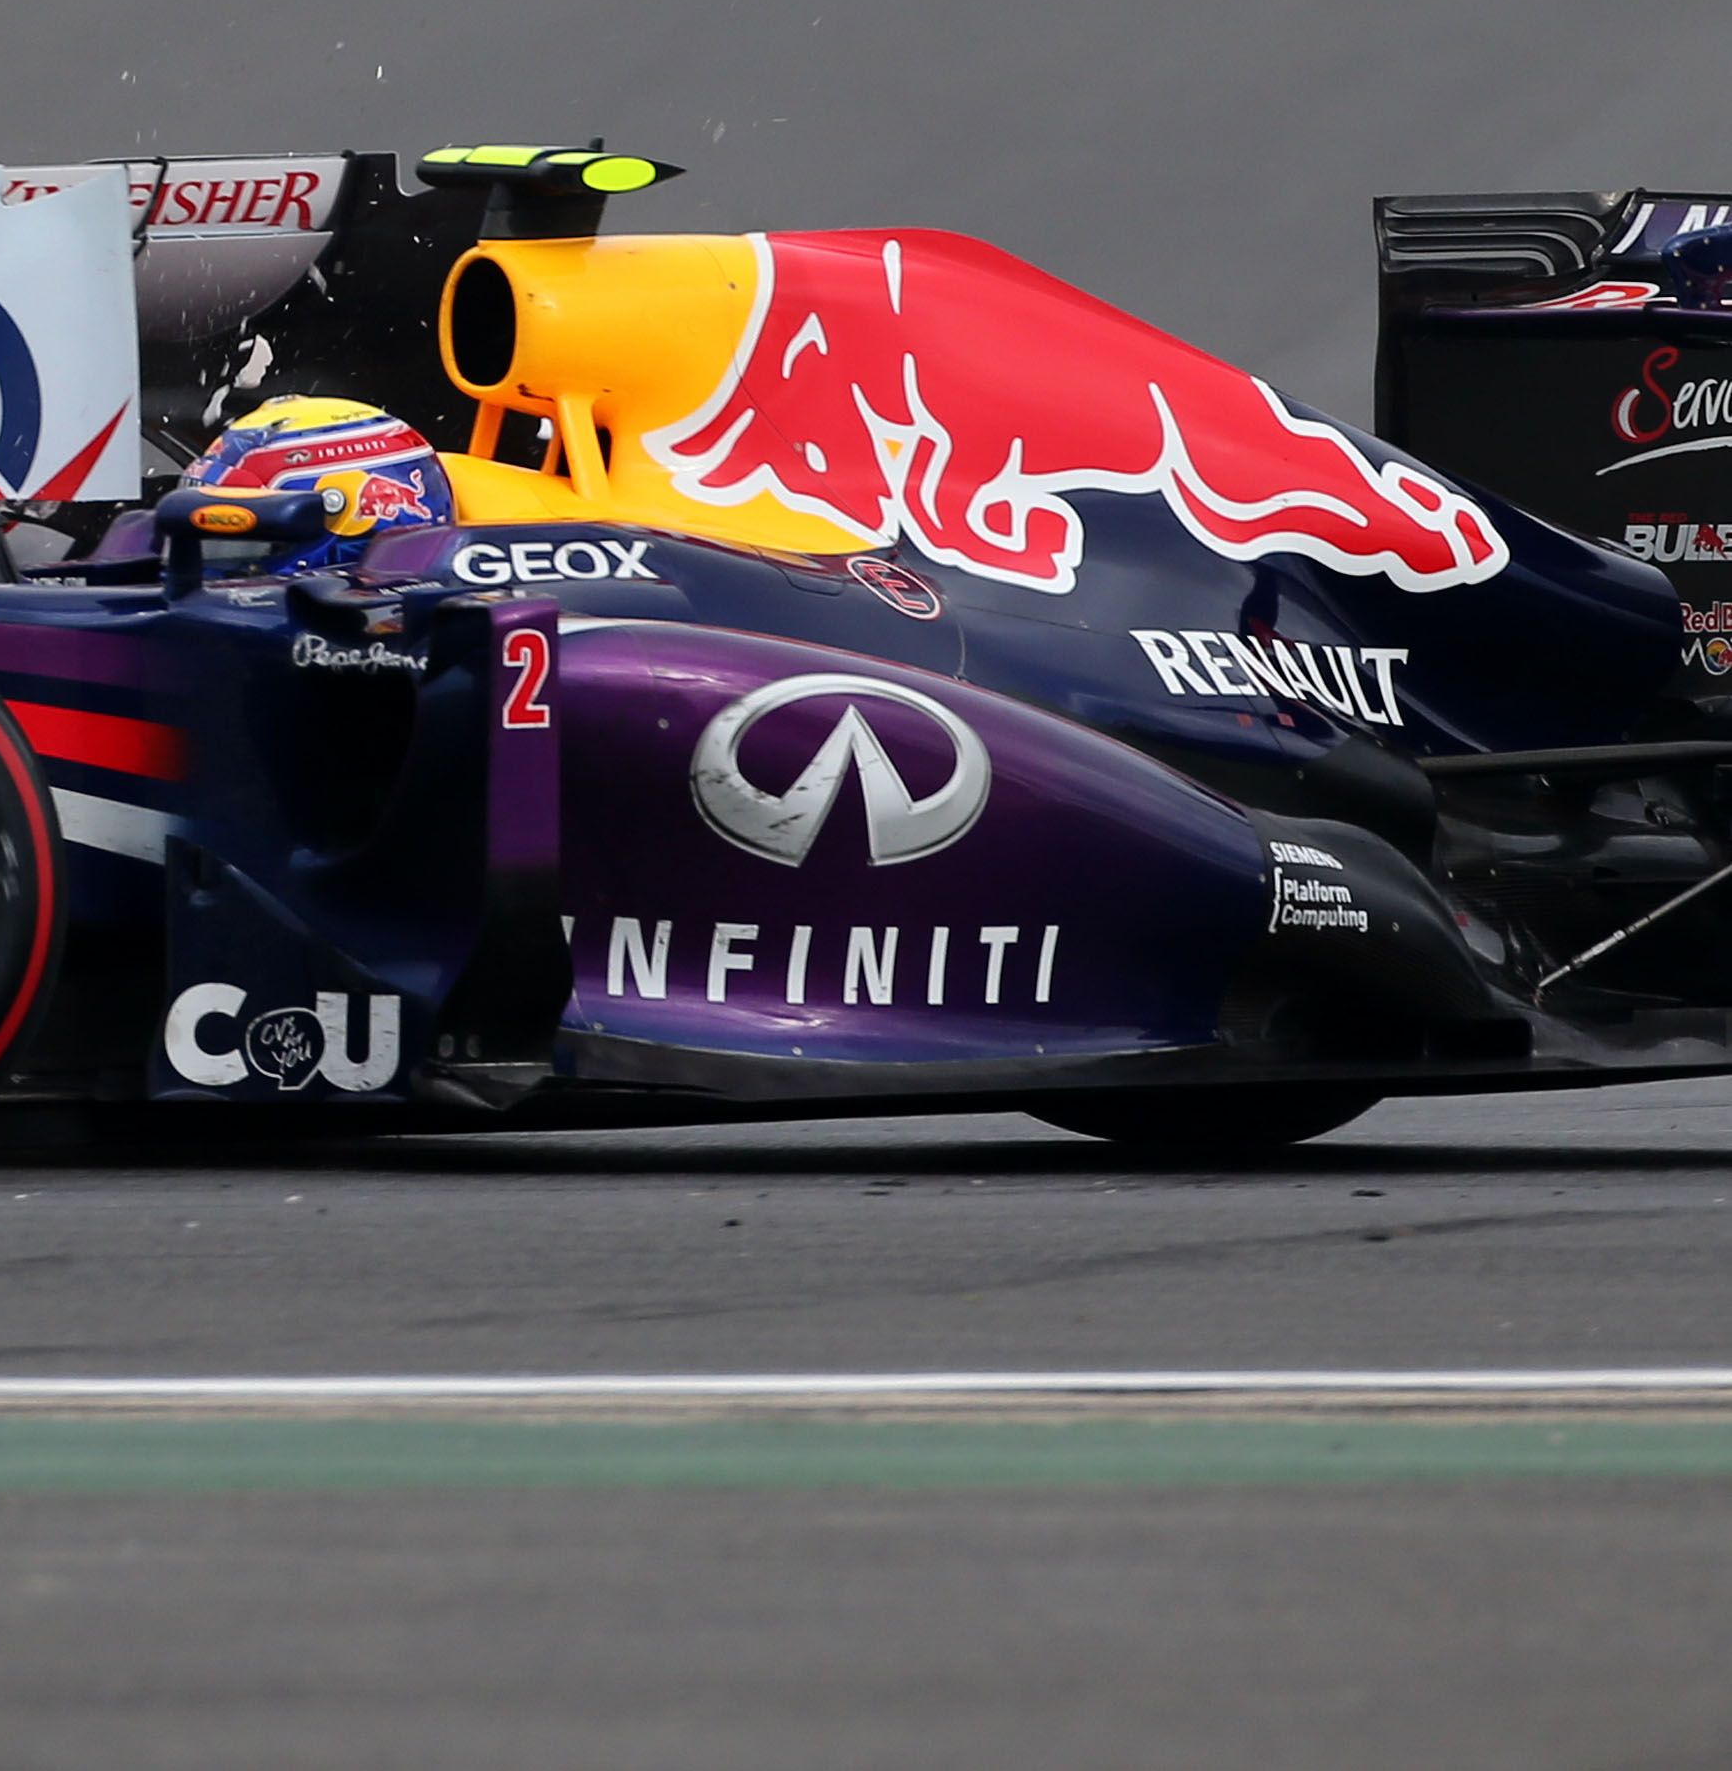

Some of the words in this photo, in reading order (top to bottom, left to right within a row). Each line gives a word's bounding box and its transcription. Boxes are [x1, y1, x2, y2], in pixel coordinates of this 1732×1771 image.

[451, 541, 659, 583] GEOX
[503, 629, 550, 729] 2
[1128, 629, 1410, 727] RENAULT
[1270, 841, 1344, 870] SIEMENS
[1284, 879, 1352, 904] Platform
[1282, 905, 1368, 932] Computing
